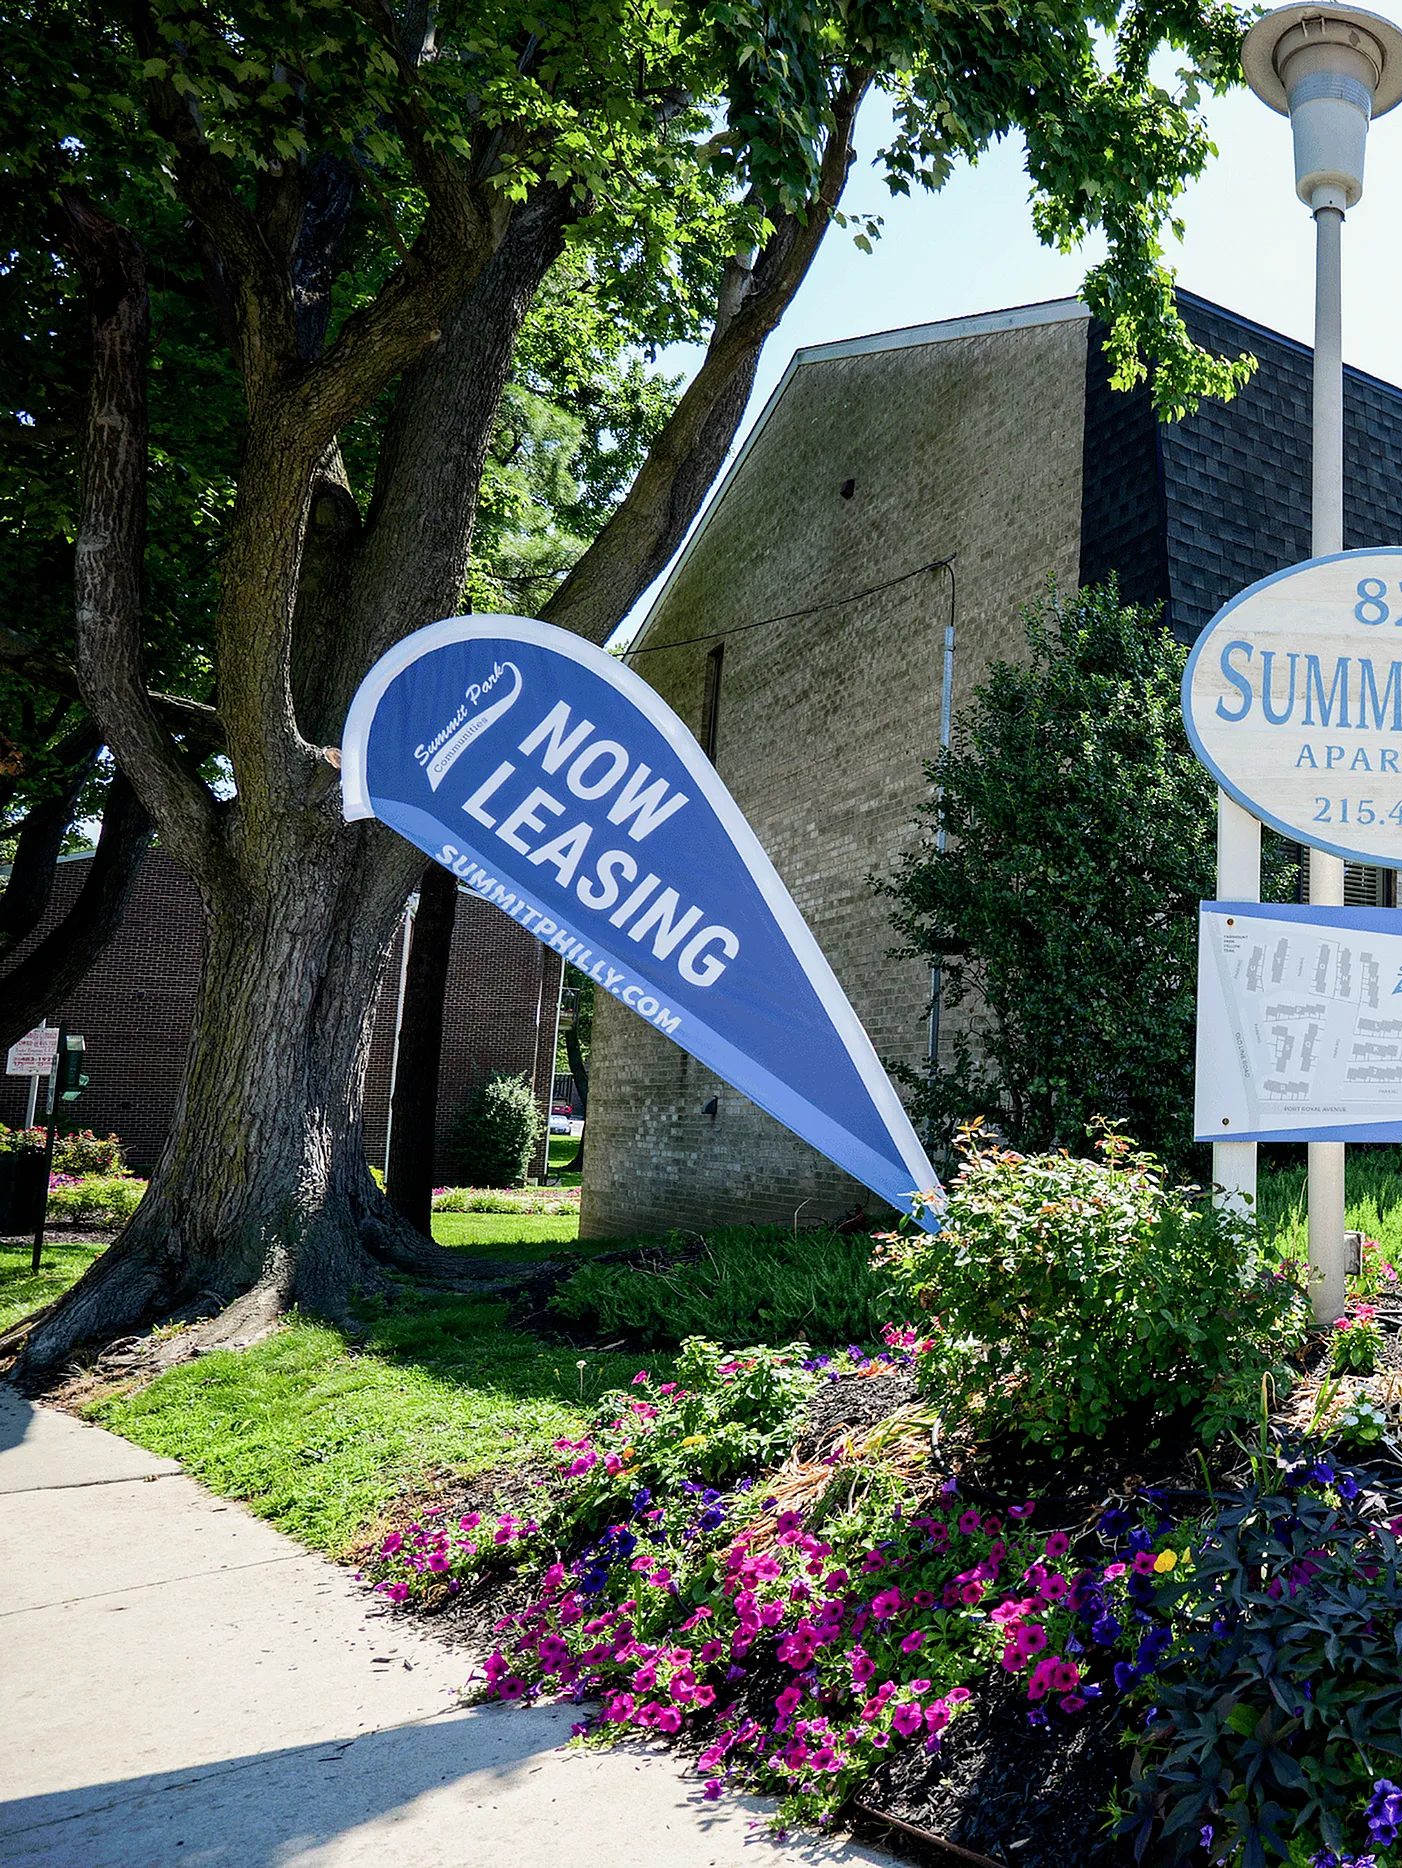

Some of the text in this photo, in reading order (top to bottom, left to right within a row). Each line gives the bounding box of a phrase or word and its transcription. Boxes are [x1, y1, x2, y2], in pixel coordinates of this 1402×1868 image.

[414, 661, 504, 766] Summit Park
[434, 717, 488, 773] Communities
[518, 700, 689, 842] NOW
[435, 844, 683, 1034] SUMMITPHILLY.COM
[461, 761, 740, 988] LEASING
